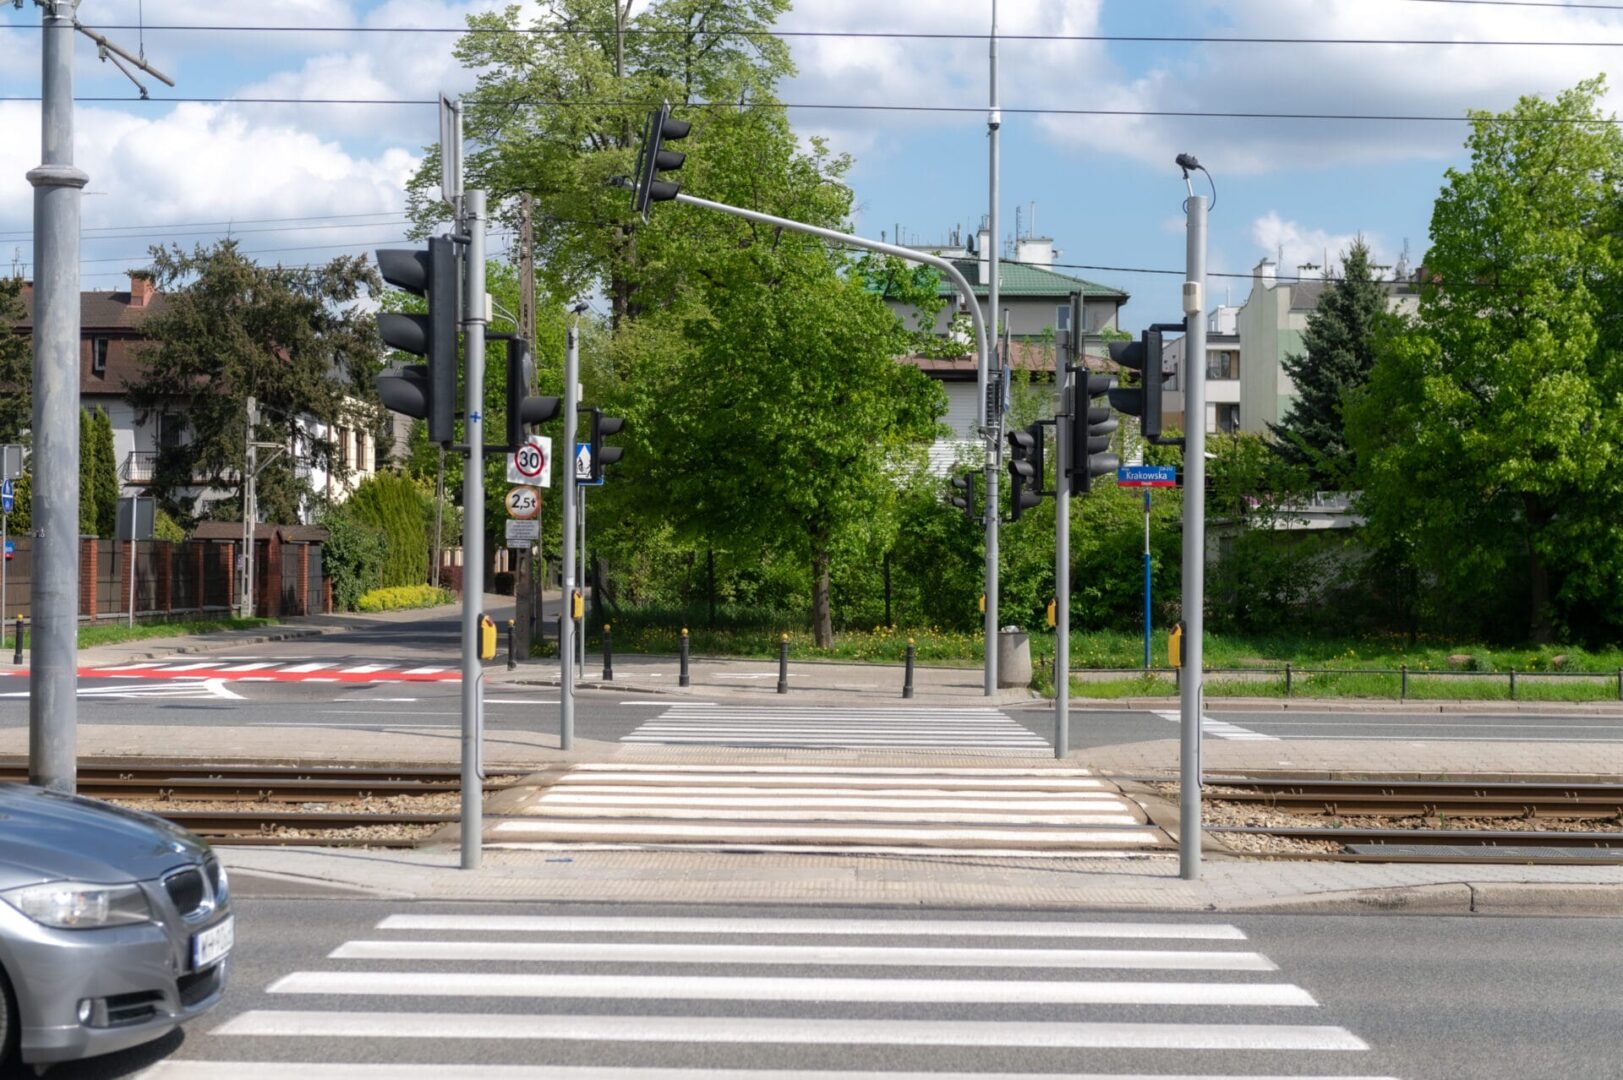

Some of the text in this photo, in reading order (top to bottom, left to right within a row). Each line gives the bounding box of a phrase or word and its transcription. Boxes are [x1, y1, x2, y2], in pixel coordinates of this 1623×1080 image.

[519, 451, 539, 469] 30
[1126, 471, 1168, 480] Krakowska
[511, 494, 536, 510] 2,5t
